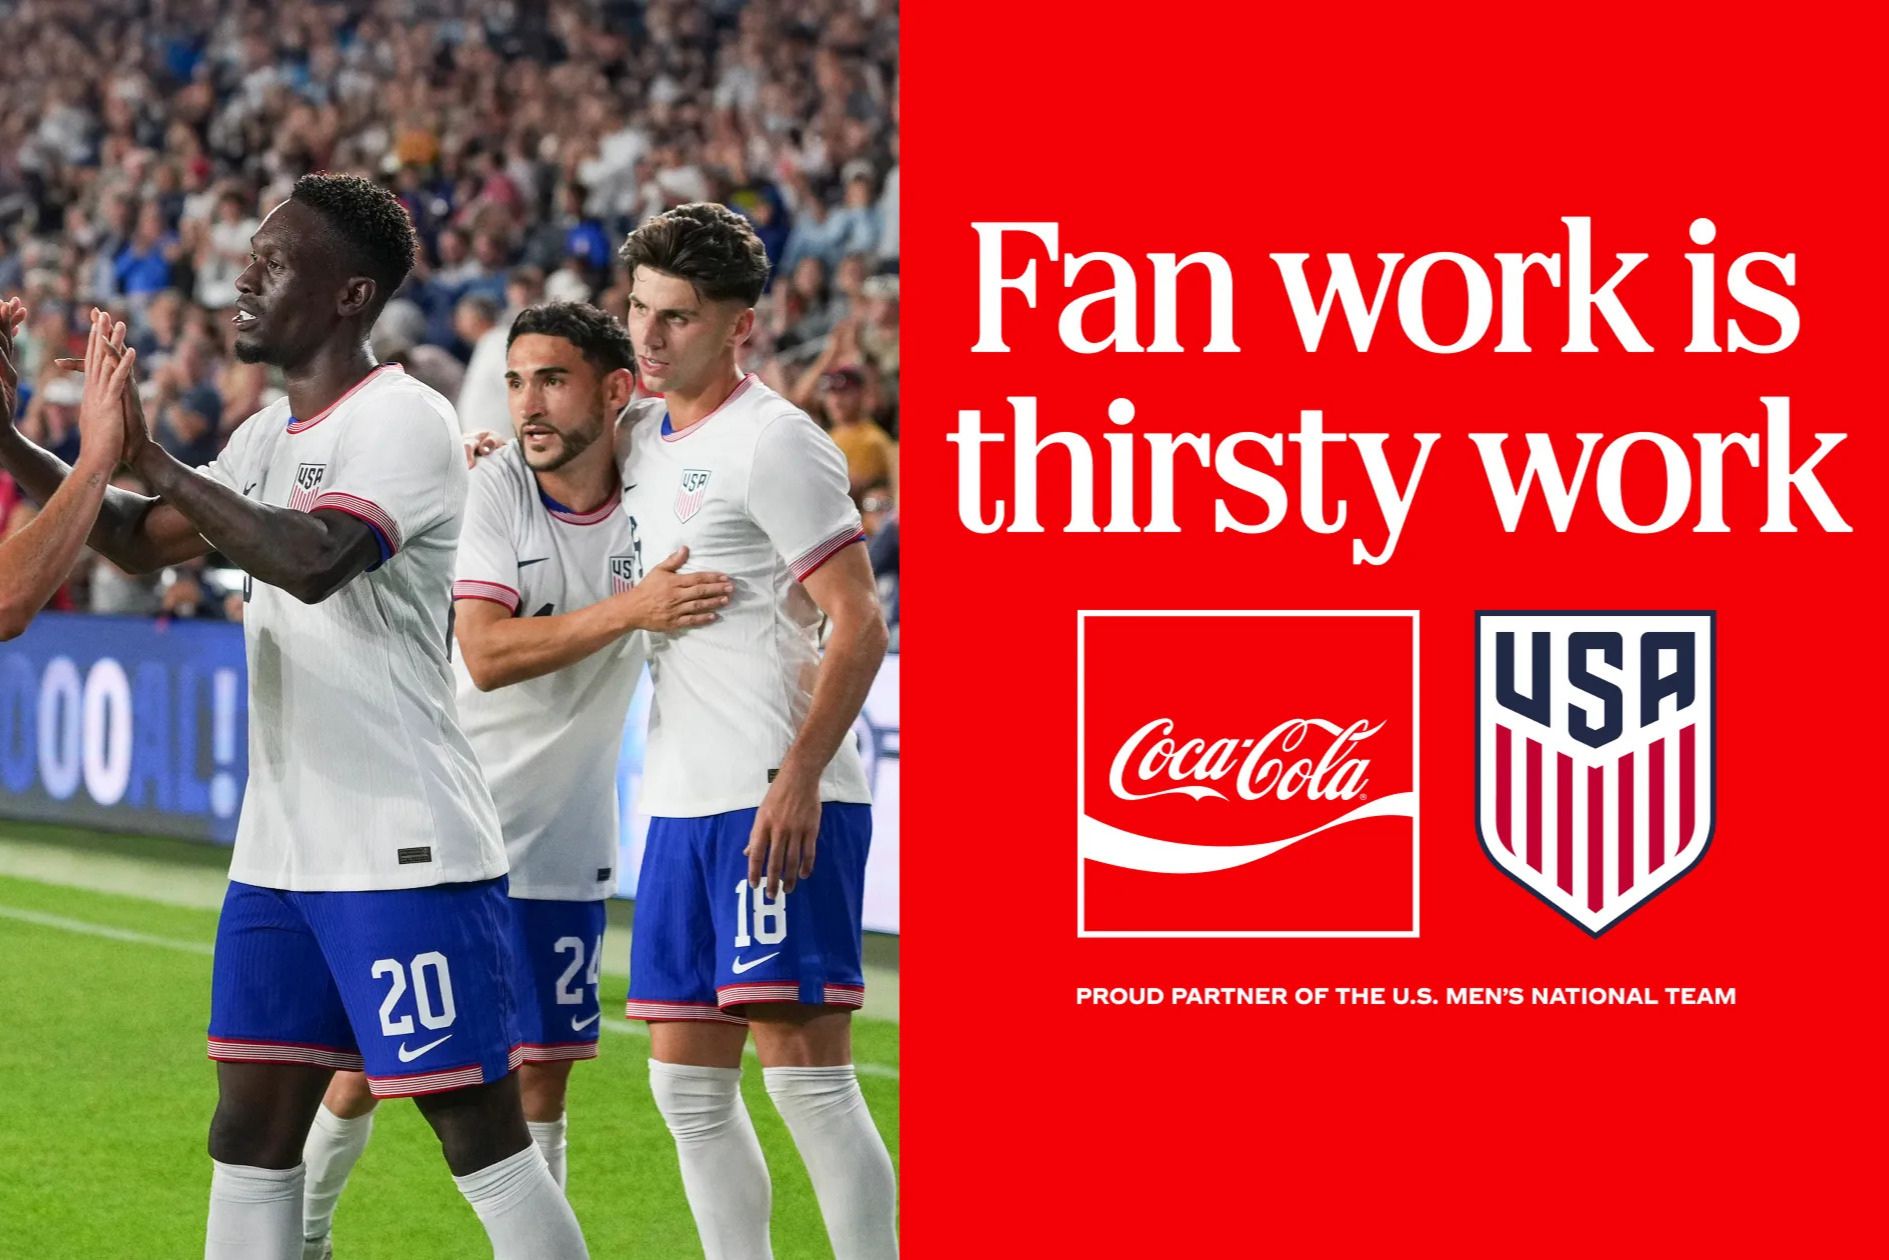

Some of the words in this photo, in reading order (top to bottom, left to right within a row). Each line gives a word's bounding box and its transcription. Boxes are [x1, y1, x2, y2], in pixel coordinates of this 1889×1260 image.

[298, 467, 324, 490] USA
[683, 473, 707, 492] USA
[612, 559, 632, 580] US
[735, 877, 787, 947] 18
[371, 951, 456, 1036] 20
